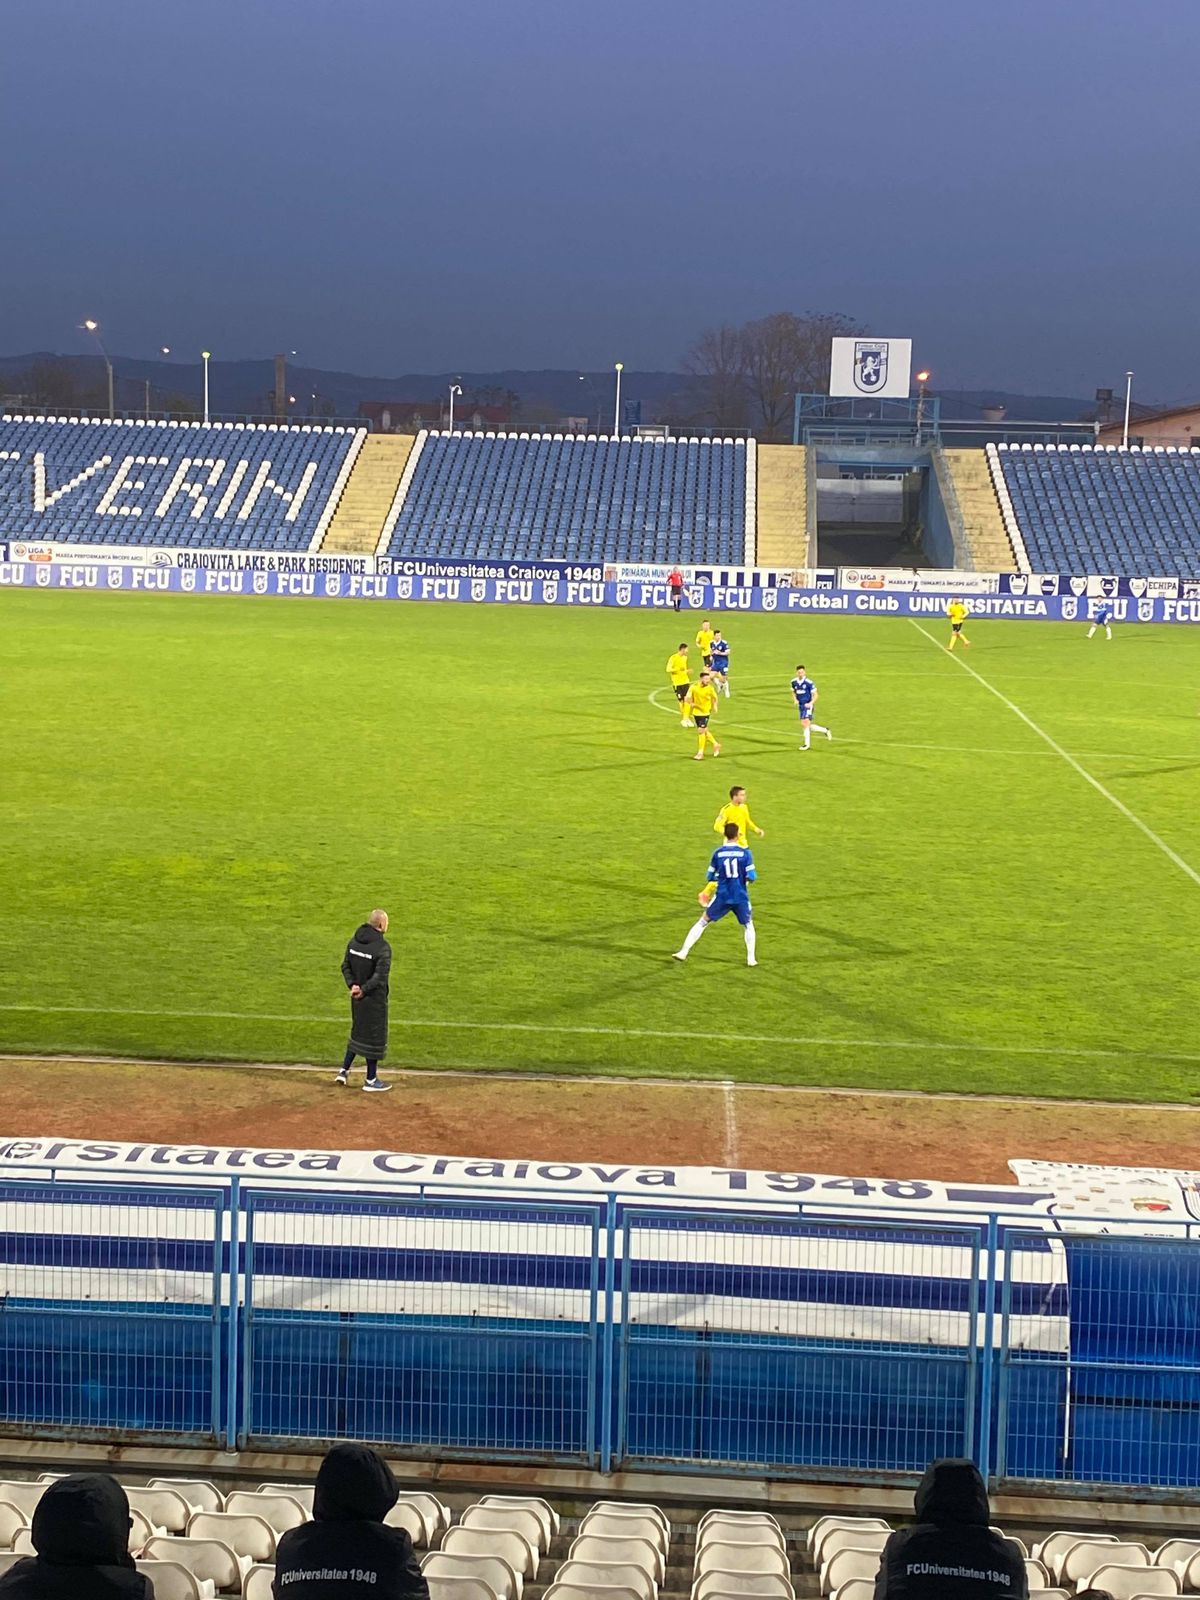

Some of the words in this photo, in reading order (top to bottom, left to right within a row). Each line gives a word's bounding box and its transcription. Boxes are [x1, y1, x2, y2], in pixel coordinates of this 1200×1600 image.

[0, 451, 318, 521] VERIN
[47, 547, 53, 555] 2
[177, 553, 234, 570] CRAIOVITA
[237, 555, 266, 571] LAKE
[267, 557, 276, 570] &
[278, 557, 306, 573] PARK
[309, 559, 366, 574] RESIDENCE
[393, 561, 505, 579] FCUniversitatea
[508, 565, 560, 580] Craiova
[564, 567, 602, 581] 1948
[60, 566, 99, 587] FCU
[132, 568, 170, 589] FCU
[205, 571, 243, 592] FCU
[277, 573, 315, 594] FCU
[349, 575, 388, 597] FCU
[422, 578, 460, 599] FCU
[495, 581, 533, 601] FCU
[566, 583, 605, 603] FCU
[713, 587, 752, 608] FCU
[788, 593, 848, 609] Fotbal
[855, 595, 899, 611] Club
[909, 597, 1047, 615] UNIVRSITATEA
[1163, 600, 1200, 622] FCU
[1148, 581, 1177, 590] ECHIPA
[723, 857, 739, 879] 11
[373, 1152, 677, 1187] Craiova
[711, 1170, 933, 1200] 1948
[281, 1567, 348, 1586] FCUniversitatea
[349, 1568, 377, 1584] 1948
[906, 1563, 985, 1580] FCUniversitatea
[987, 1569, 1011, 1587] 1948
